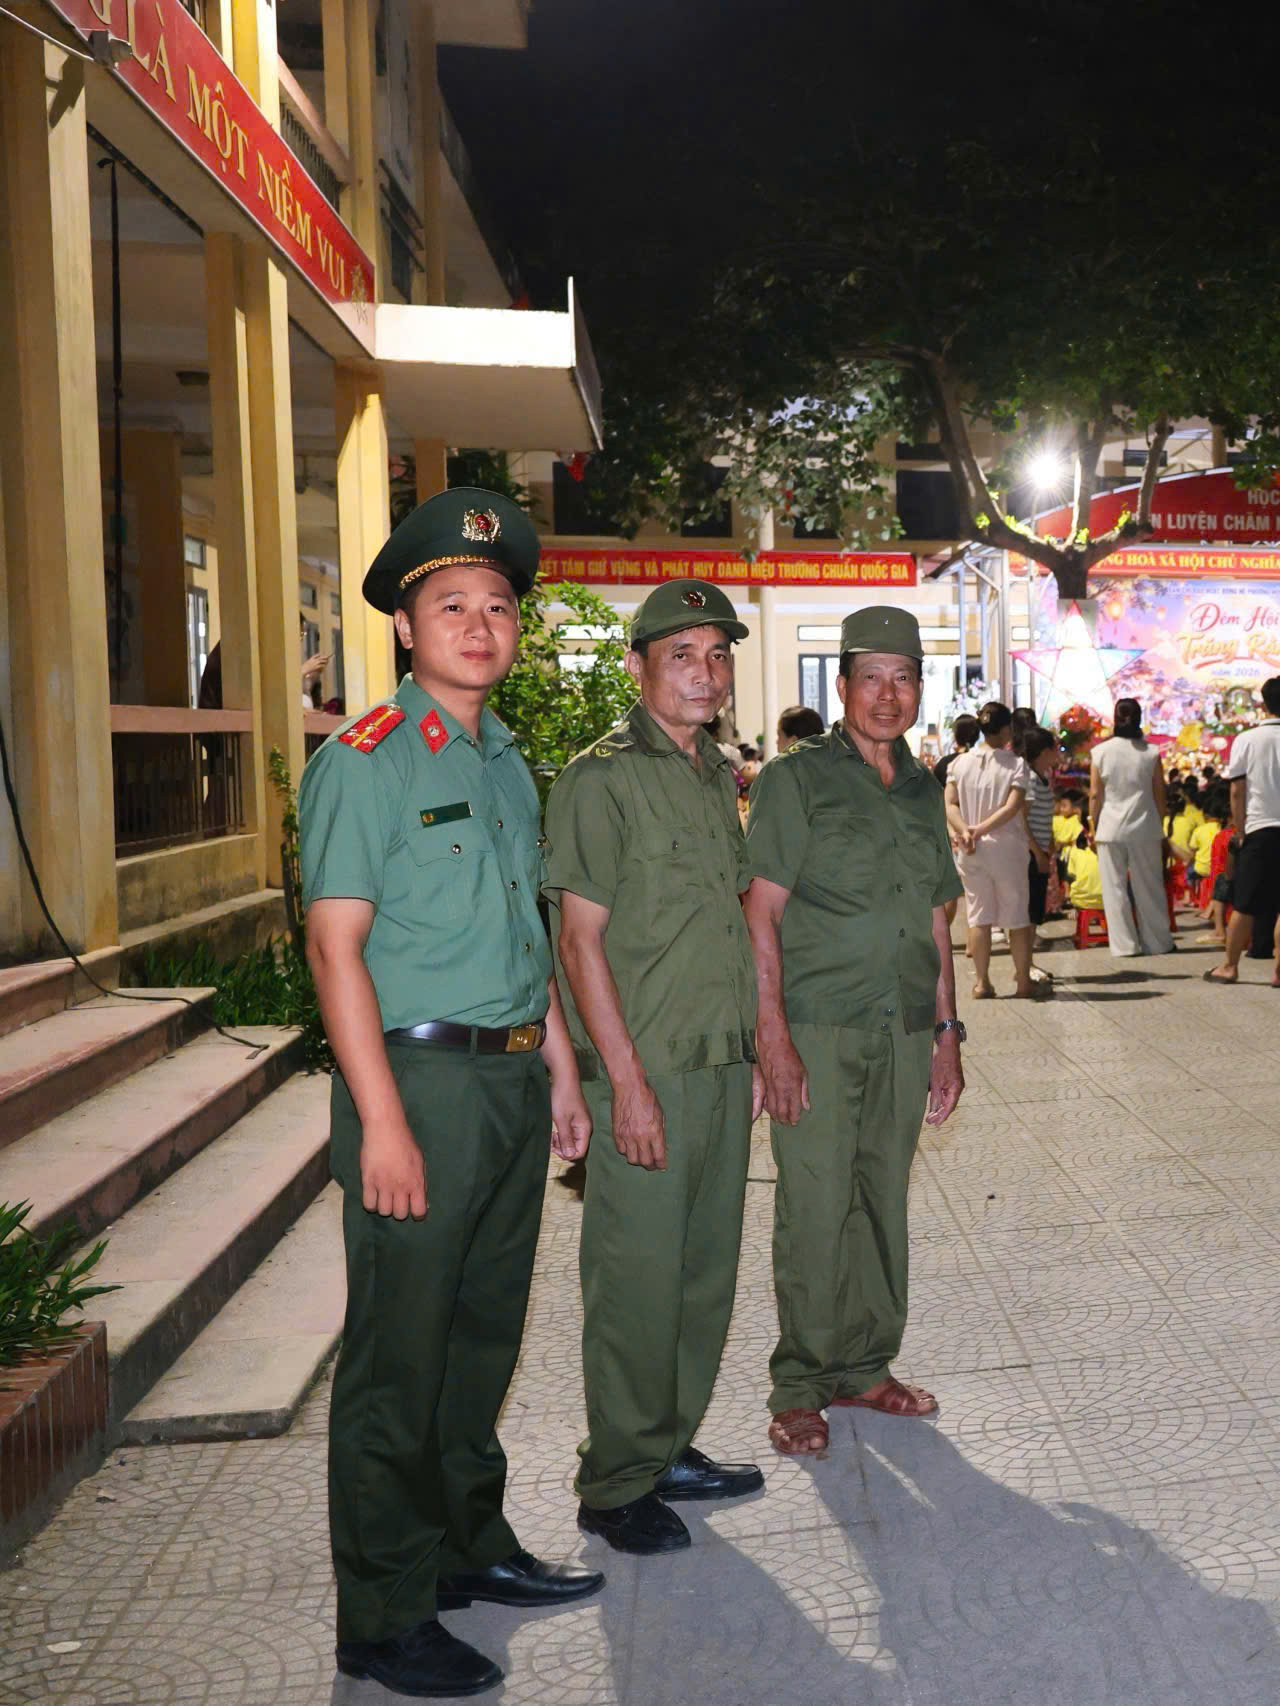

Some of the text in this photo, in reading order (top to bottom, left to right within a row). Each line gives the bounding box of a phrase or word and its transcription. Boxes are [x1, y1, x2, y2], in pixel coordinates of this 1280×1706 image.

[186, 63, 249, 181] MỘT
[257, 149, 313, 259] NIỀM
[316, 224, 346, 298] VUI
[1247, 488, 1280, 509] HỌC
[1167, 511, 1218, 534] LUYỆN
[1223, 511, 1270, 531] CHĂM
[644, 556, 659, 577] VÀ
[662, 557, 690, 577] PHÁT
[693, 560, 714, 577] HUY
[718, 561, 748, 578] DANH
[750, 559, 775, 581] HIỆU
[860, 559, 889, 581] QUỐC
[890, 562, 909, 580] GIA
[1126, 552, 1156, 567] HOÀ
[1159, 553, 1178, 567] XÃ
[1179, 553, 1206, 572] HỘI
[1208, 554, 1235, 568] CHỦ
[1190, 602, 1280, 632] Đêm Hội
